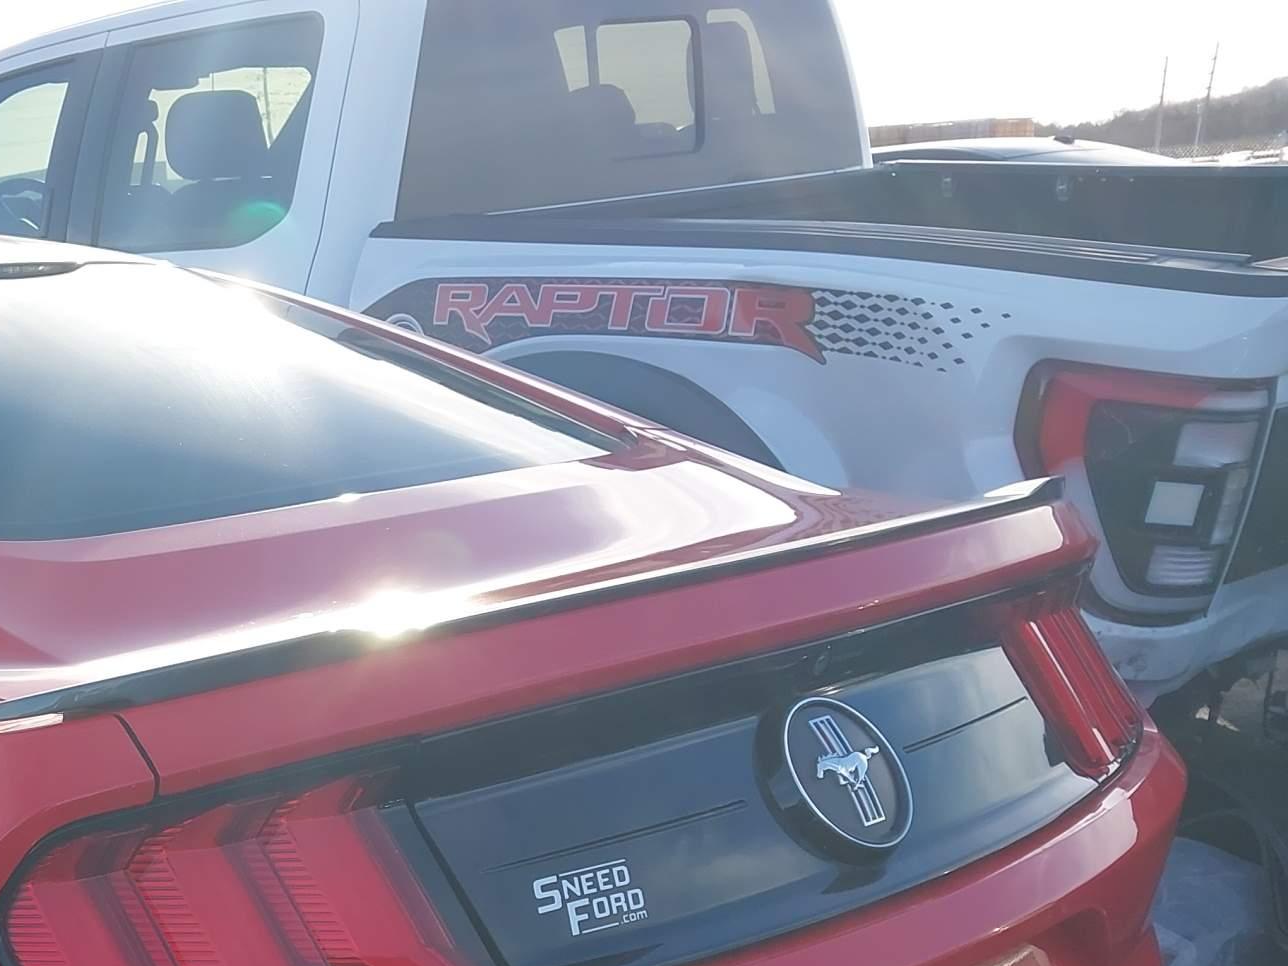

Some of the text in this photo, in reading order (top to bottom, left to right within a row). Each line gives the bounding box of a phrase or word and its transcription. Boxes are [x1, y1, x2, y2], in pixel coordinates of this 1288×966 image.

[433, 283, 827, 365] RAPTOR
[533, 865, 630, 914] SNEED
[567, 888, 644, 936] FORD
[621, 909, 648, 924] .com
